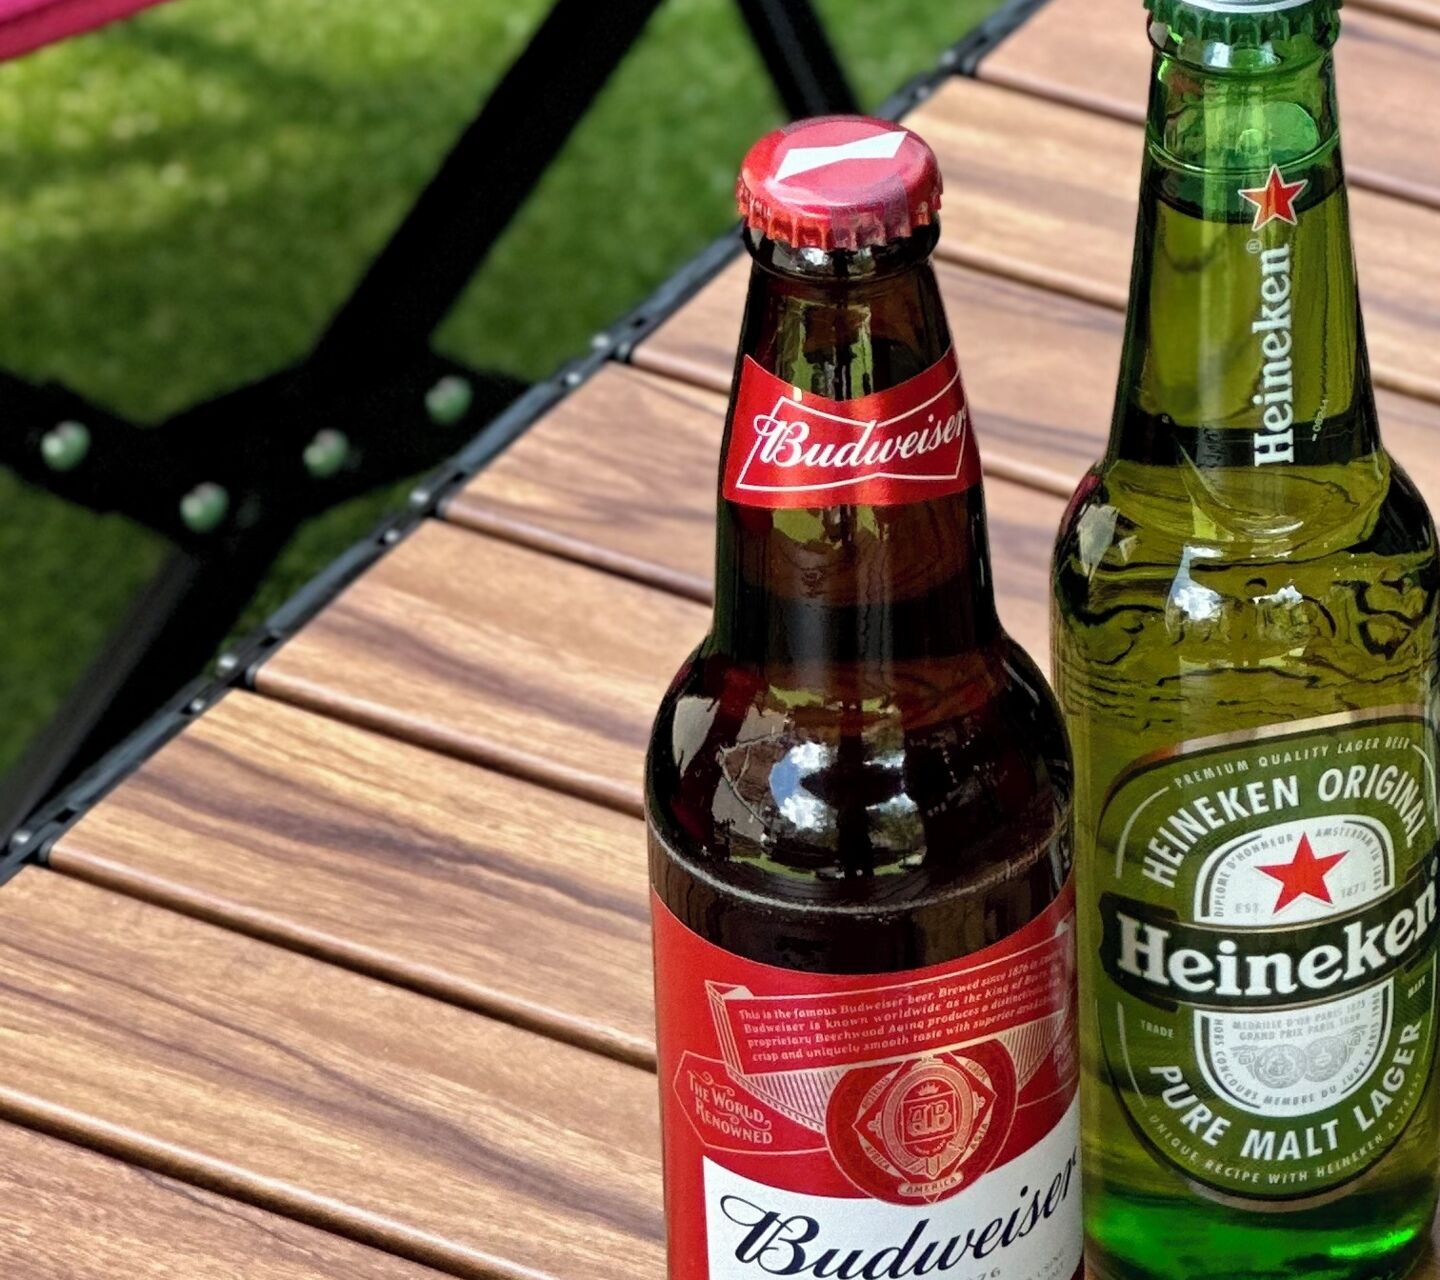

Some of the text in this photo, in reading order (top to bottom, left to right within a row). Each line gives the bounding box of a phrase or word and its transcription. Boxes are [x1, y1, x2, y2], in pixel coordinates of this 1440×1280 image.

[1252, 243, 1295, 467] Heineken
[754, 407, 967, 467] Budweiser
[1174, 758, 1249, 789] PREMIUM
[1258, 744, 1329, 768] QUALITY
[1337, 737, 1379, 755] LAGER
[1141, 763, 1426, 888] HEINEKEN ORIGINAL
[1315, 826, 1375, 848] AMSTERDAM
[1213, 870, 1230, 918] DIPLOME
[1115, 881, 1438, 996] Heineken
[739, 1009, 761, 1021] This
[774, 1007, 791, 1019] the
[793, 1007, 837, 1020] famous
[840, 997, 904, 1016] Budweiser
[938, 977, 979, 999] Brewed
[744, 992, 983, 1035] Budweiser known worldwide the
[747, 1006, 979, 1049] proprietary Beechwood Aging produces
[752, 1052, 779, 1063] crisp
[781, 1049, 803, 1060] and
[806, 1044, 860, 1060] uniquely
[863, 1034, 909, 1051] smooth
[913, 1030, 942, 1043] taste
[946, 1020, 971, 1036] with
[973, 1009, 1015, 1028] superior
[1140, 1018, 1175, 1040] TRADE
[687, 1070, 764, 1122] THE WORLD
[1149, 1020, 1423, 1162] PURE MALT LAGER
[1214, 1050, 1260, 1101] CONCOURS
[1262, 1085, 1337, 1106] MEMBRE DU
[695, 1097, 773, 1144] RENOWNED
[864, 1144, 891, 1171] AFRICA
[1149, 1114, 1384, 1185] UNIQUE RECIPE WITH HEINEKEN
[906, 1176, 957, 1194] AMERICA
[720, 1146, 1079, 1280] Budweiser
